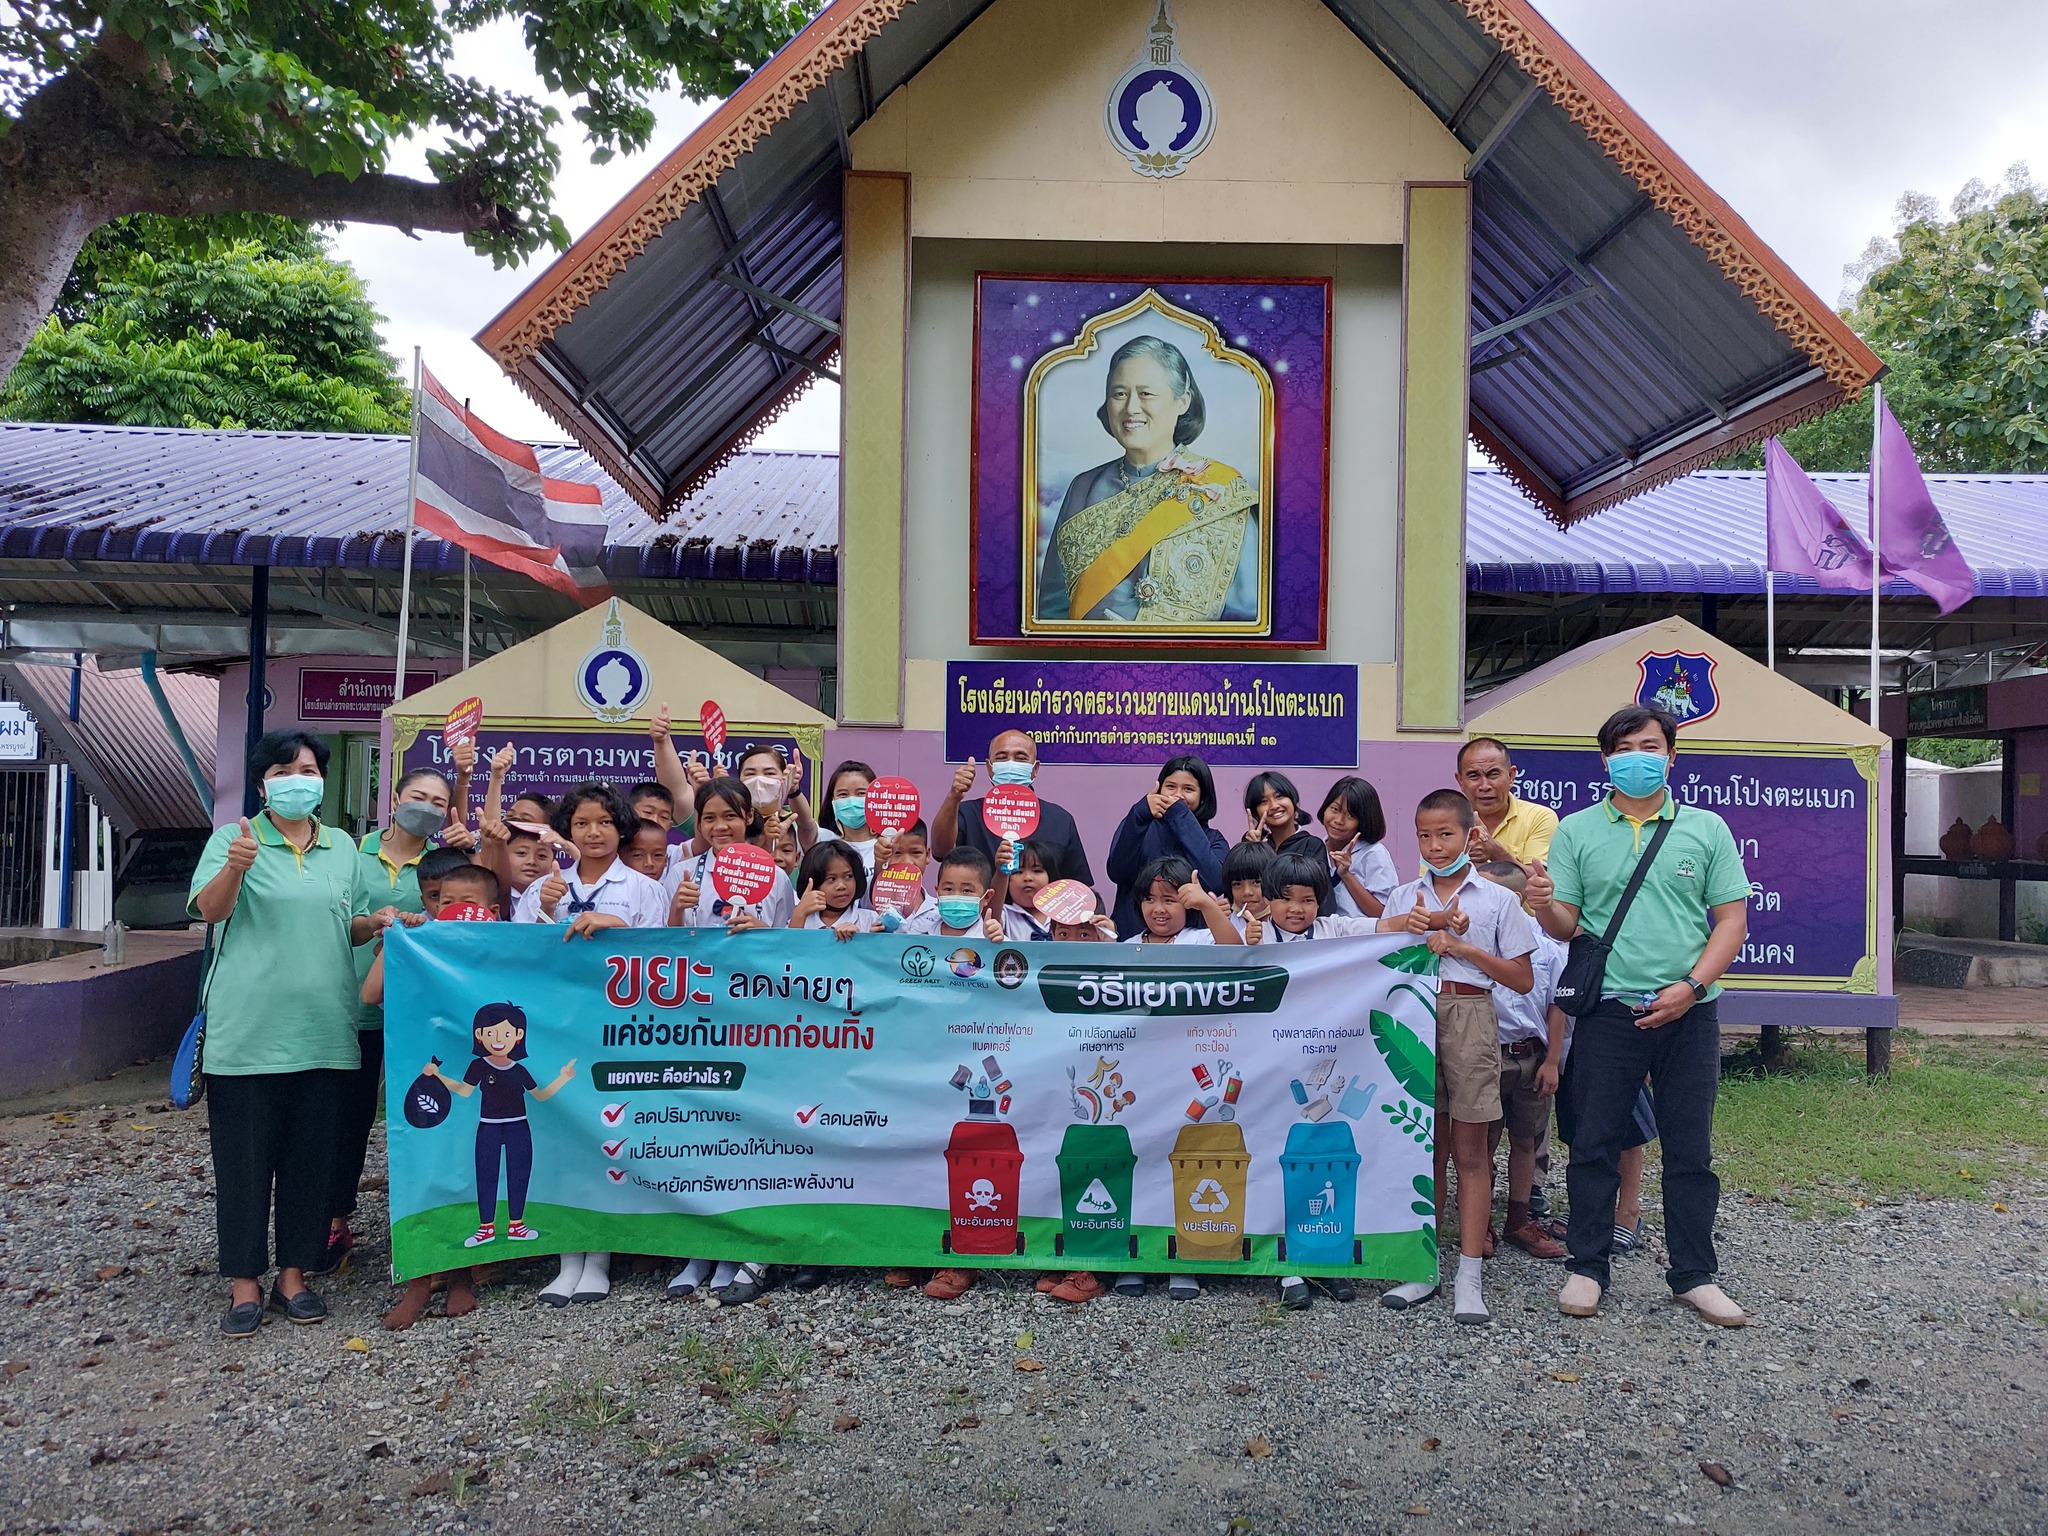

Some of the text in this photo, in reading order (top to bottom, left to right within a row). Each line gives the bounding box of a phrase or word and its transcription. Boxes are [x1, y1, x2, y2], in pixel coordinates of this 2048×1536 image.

[958, 675, 1344, 718] โรงเรียนตำรวจตระเวนชายแดนบ้านโป่งตะแบก
[1260, 735, 1277, 746] ๓๑
[1512, 769, 1577, 810] รัชญา
[604, 954, 855, 1012] ขยะ ลดง่ายๆ
[1077, 972, 1256, 1008] วิธีแยกขยะ
[1554, 986, 1576, 998] didas
[602, 1011, 875, 1050] แค่ช่วยกันแยกก่อนทิ้ง
[947, 1022, 1034, 1036] หลอดไฟ ถ่ายไฟฉาย
[1068, 1026, 1137, 1039] ผัก เปลือกผลไม้
[1186, 1023, 1238, 1038] แก้ว ขวดน้ำ
[1272, 1026, 1365, 1042] ถุงพลาสติก กล่องนม
[1079, 1041, 1125, 1052] เศษอาหาร
[1195, 1040, 1230, 1053] กระป๋อง
[1302, 1043, 1337, 1054] กระดาษ
[608, 1066, 733, 1085] แยกขยะ ดีอย่างไร ?
[633, 1106, 742, 1125] ลดปริมาณขยะ
[819, 1110, 889, 1128] ลดมลพิษ
[629, 1136, 814, 1160] เปลี่ยนภาพเมืองให้น่ามอง
[632, 1173, 855, 1194] ประหยัดทรัพยากรและพลังงาน
[954, 1215, 1014, 1228] ขยะอันตราย
[1069, 1217, 1125, 1230] ขยะอินทรีย์
[1183, 1218, 1238, 1234] ขยะรีไซเคิล
[1297, 1217, 1342, 1235] ขยะทั่วไป
